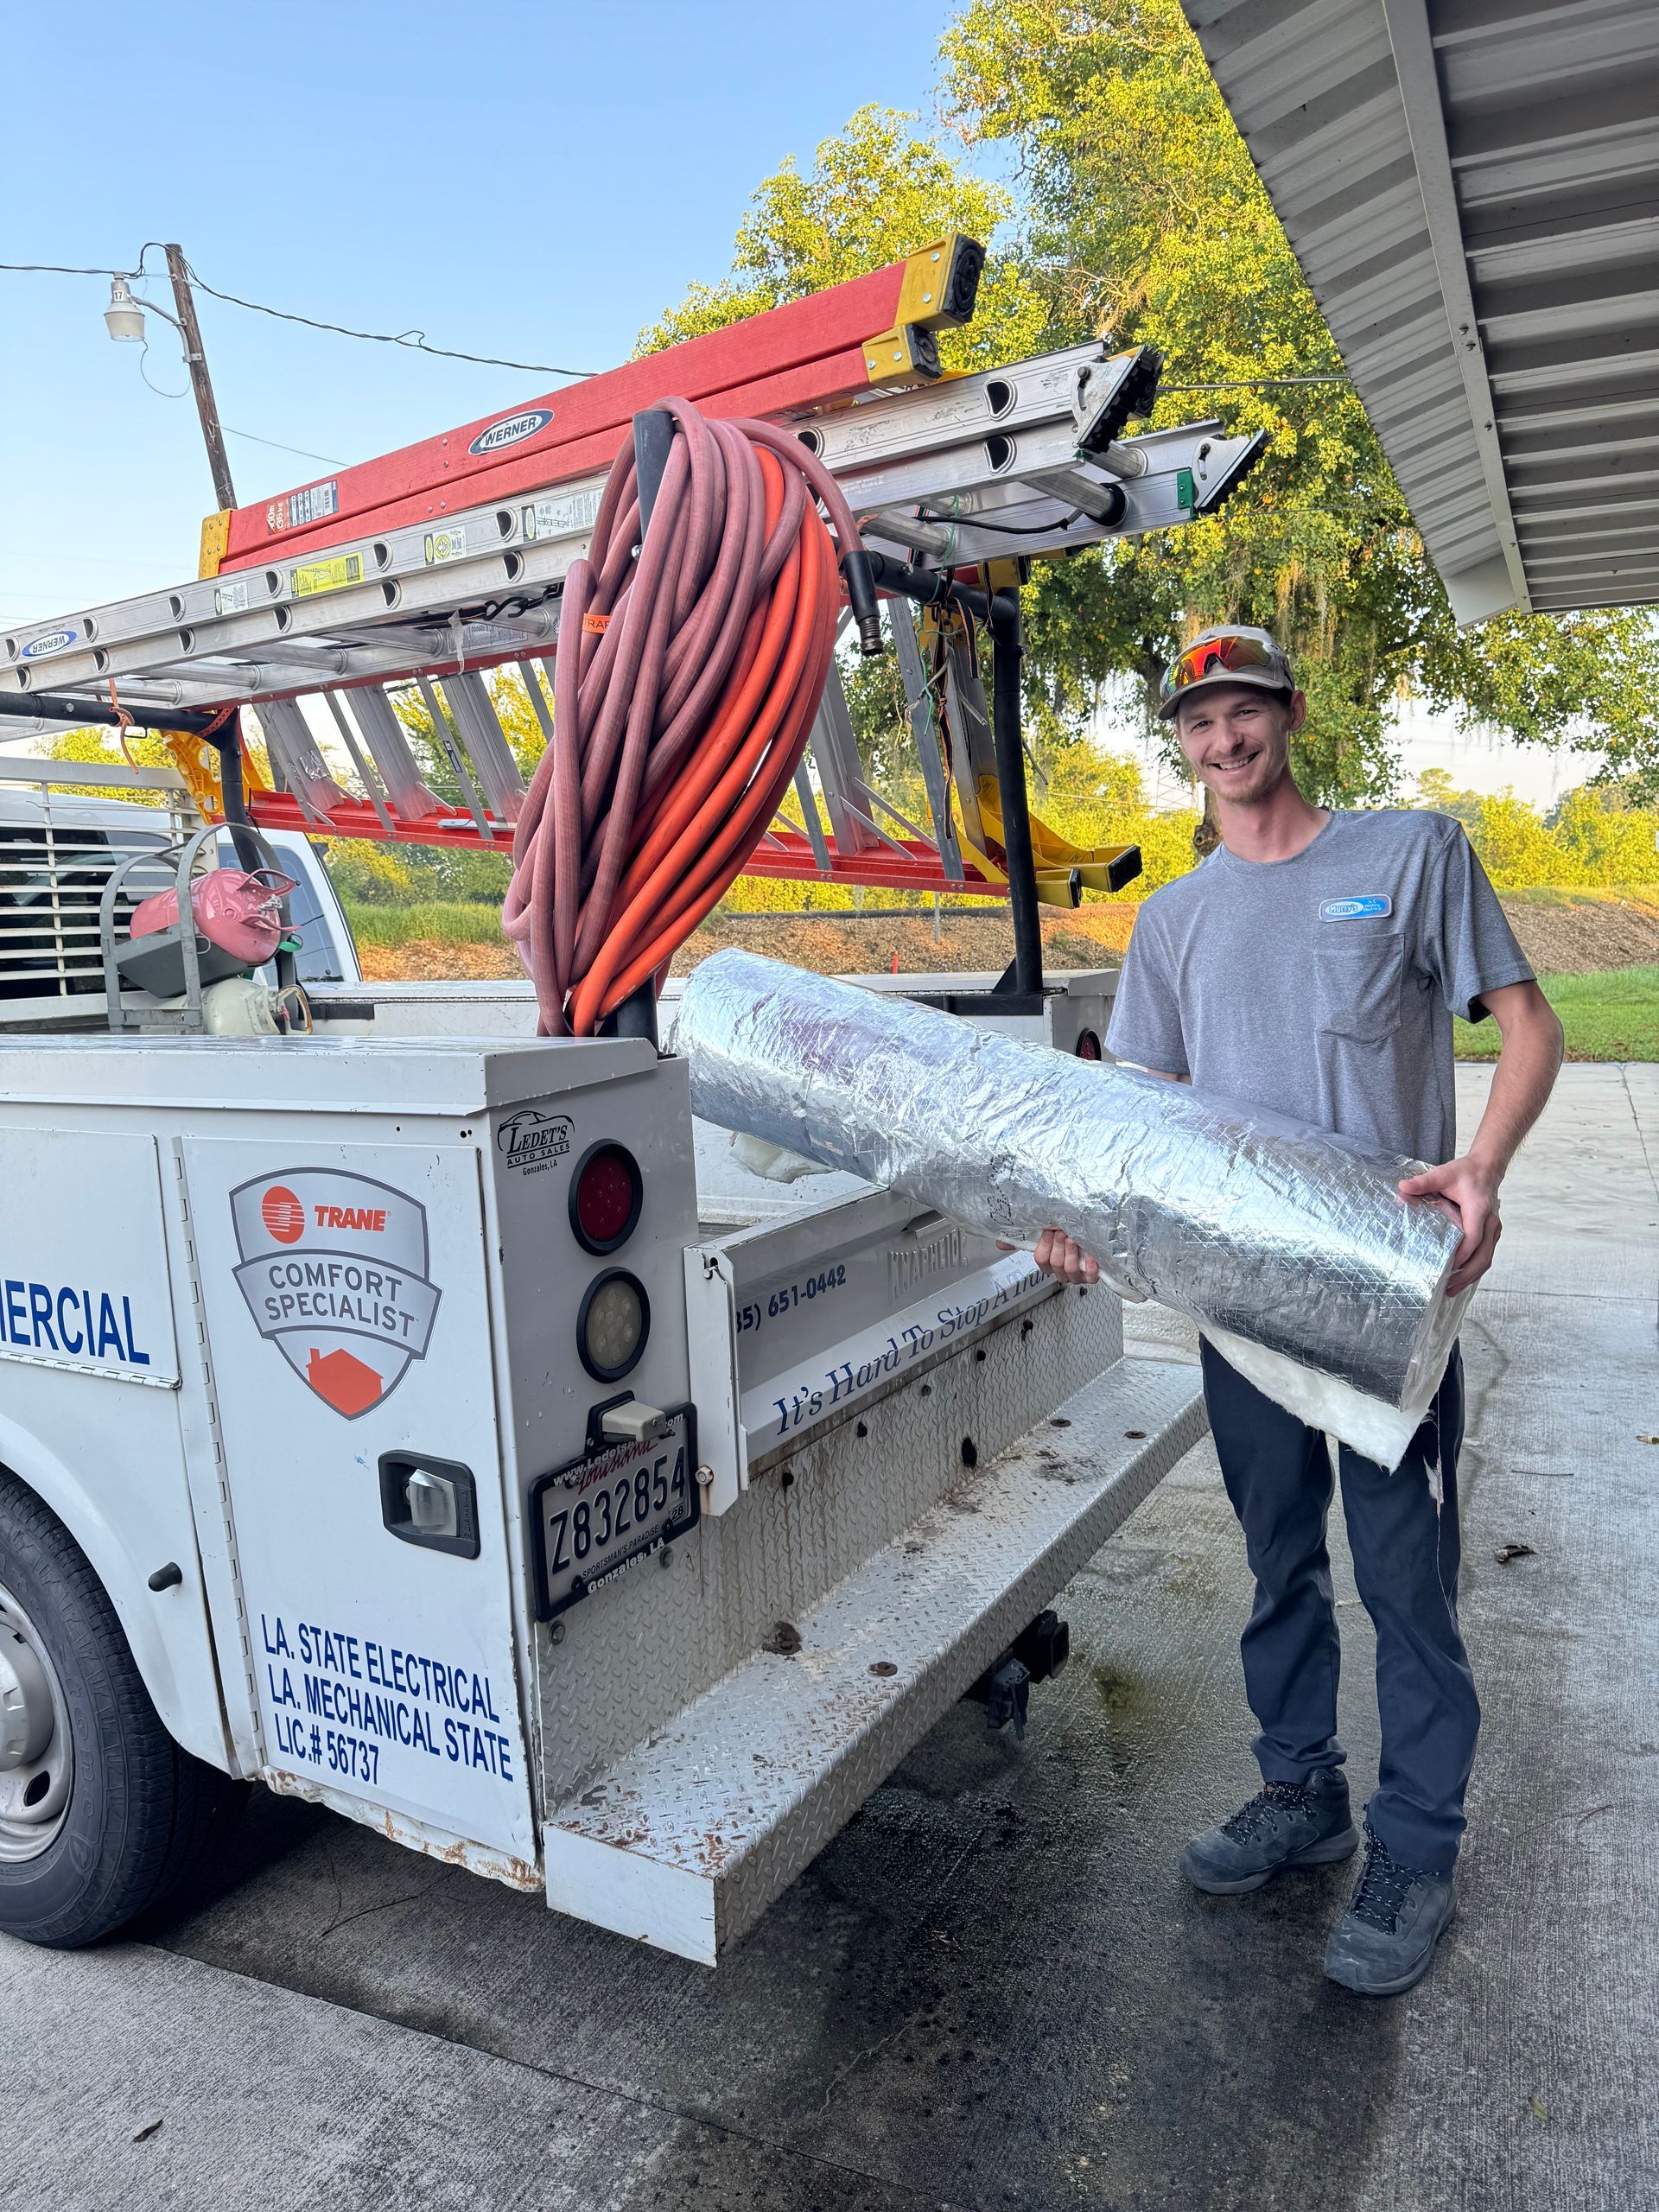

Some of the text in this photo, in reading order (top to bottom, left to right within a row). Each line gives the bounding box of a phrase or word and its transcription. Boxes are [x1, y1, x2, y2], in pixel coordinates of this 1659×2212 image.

[485, 416, 537, 446] WERNER
[32, 635, 66, 653] WERNER
[1330, 903, 1358, 913] Murry's
[506, 1143, 570, 1166] AUTO SALES
[507, 1125, 568, 1154] LEDET'S
[523, 1159, 557, 1175] Gonzales, LA
[315, 1205, 386, 1231] TRANE
[269, 1262, 402, 1302] COMFORT
[768, 1264, 846, 1318] 651-0442
[0, 1279, 150, 1365] ERCIAL
[265, 1292, 415, 1337] SPECIALIST
[772, 1386, 823, 1435] It's
[825, 1338, 901, 1405] Hard
[901, 1324, 934, 1358] To
[938, 1298, 989, 1339] Stop
[992, 1281, 1009, 1310] A
[550, 1445, 686, 1575] Z832854
[671, 1505, 683, 1520] 28
[582, 1524, 659, 1580] SPORTSMAN'S PARADISE
[588, 1537, 665, 1594] Gonzales, LA
[261, 1614, 499, 1724] LA. STATE ELECTRICAL
[268, 1663, 513, 1782] LA. MECHANICAL STATE
[275, 1713, 379, 1785] LIC.# 56737
